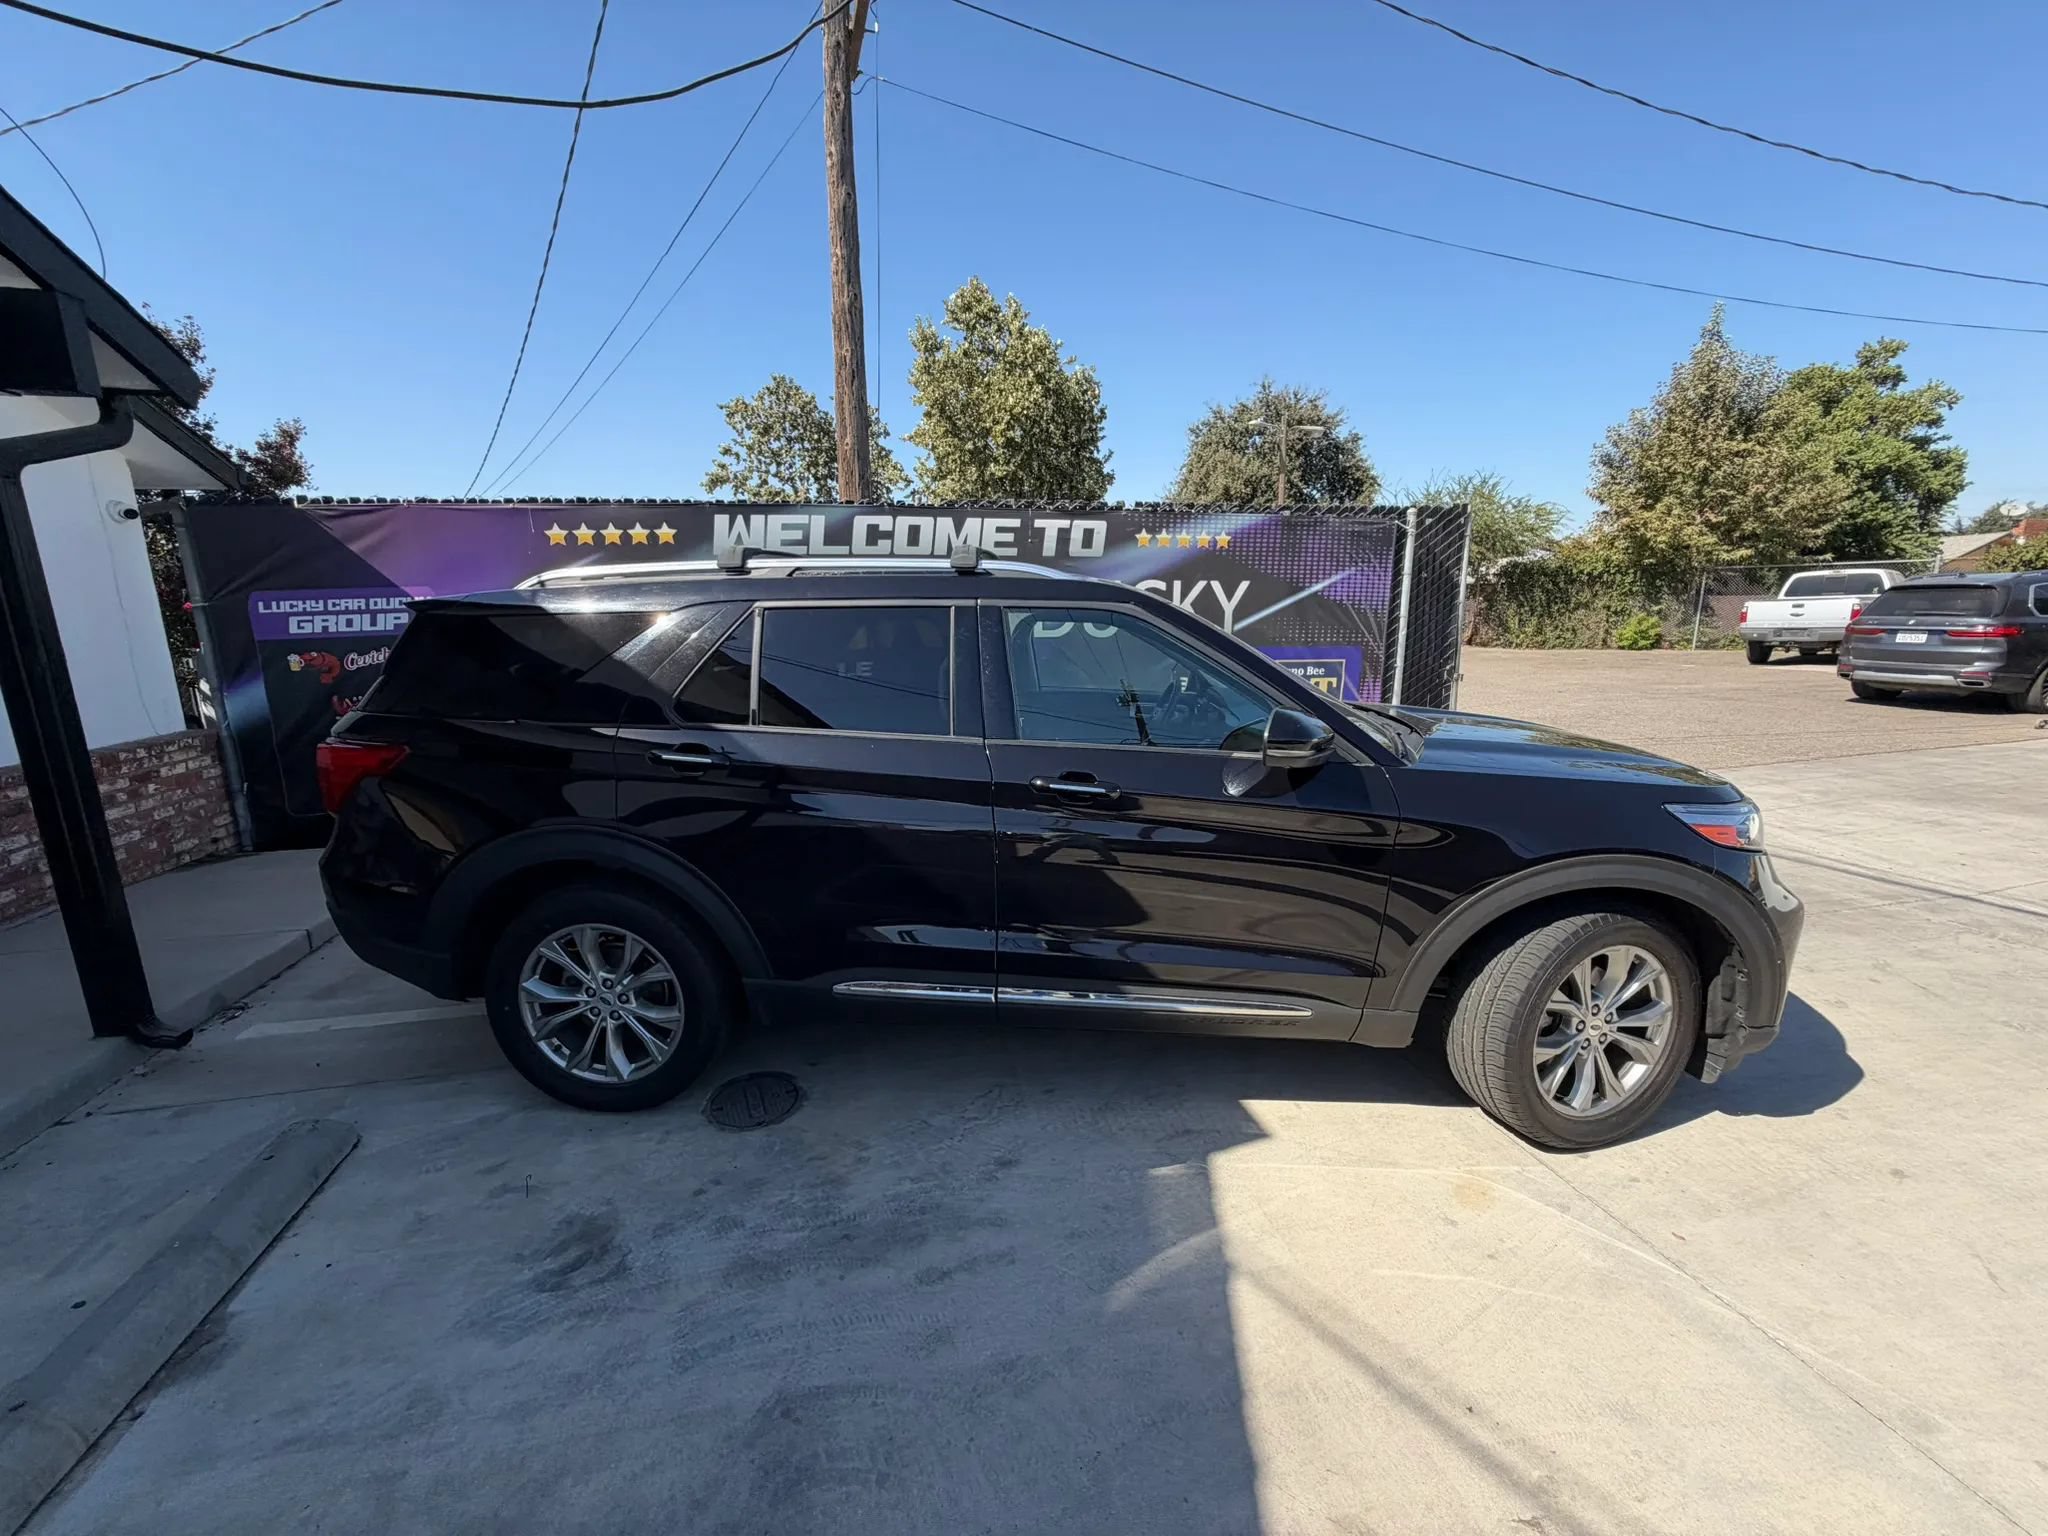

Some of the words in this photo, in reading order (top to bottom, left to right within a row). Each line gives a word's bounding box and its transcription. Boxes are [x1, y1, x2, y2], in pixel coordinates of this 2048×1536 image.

[713, 514, 1021, 557] WELCOME
[1034, 519, 1107, 557] TO
[327, 598, 366, 611] CAR
[369, 597, 432, 610] DUC
[288, 612, 409, 634] GROUP
[1306, 666, 1325, 675] Bee
